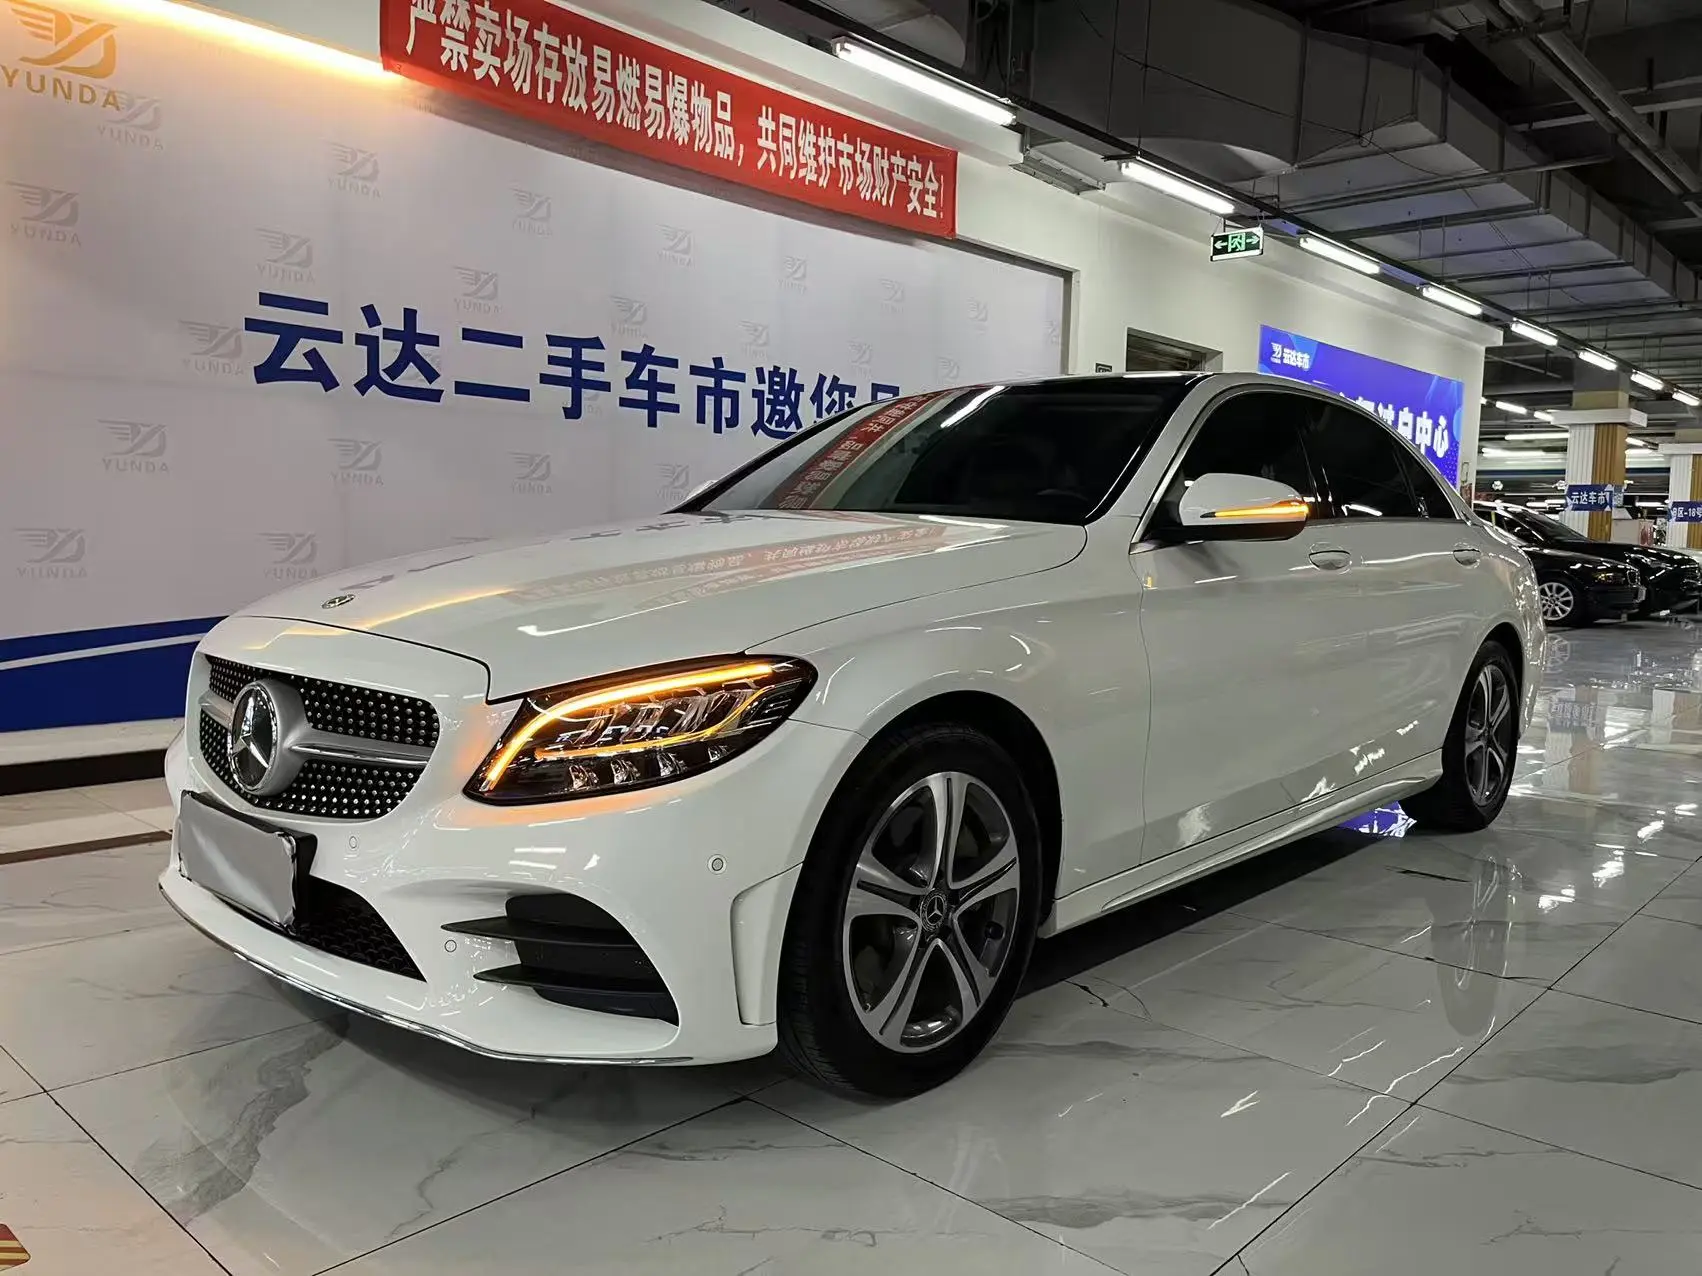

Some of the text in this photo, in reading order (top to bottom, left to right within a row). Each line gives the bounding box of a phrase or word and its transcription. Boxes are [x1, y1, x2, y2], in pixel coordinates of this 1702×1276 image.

[0, 64, 122, 112] YUNDA
[97, 125, 164, 151] YUNDA
[183, 358, 245, 376] YUNDA
[244, 292, 899, 440] 云达二手车市邀您
[102, 458, 170, 475] YUNDA
[1571, 491, 1606, 505] 云达车市
